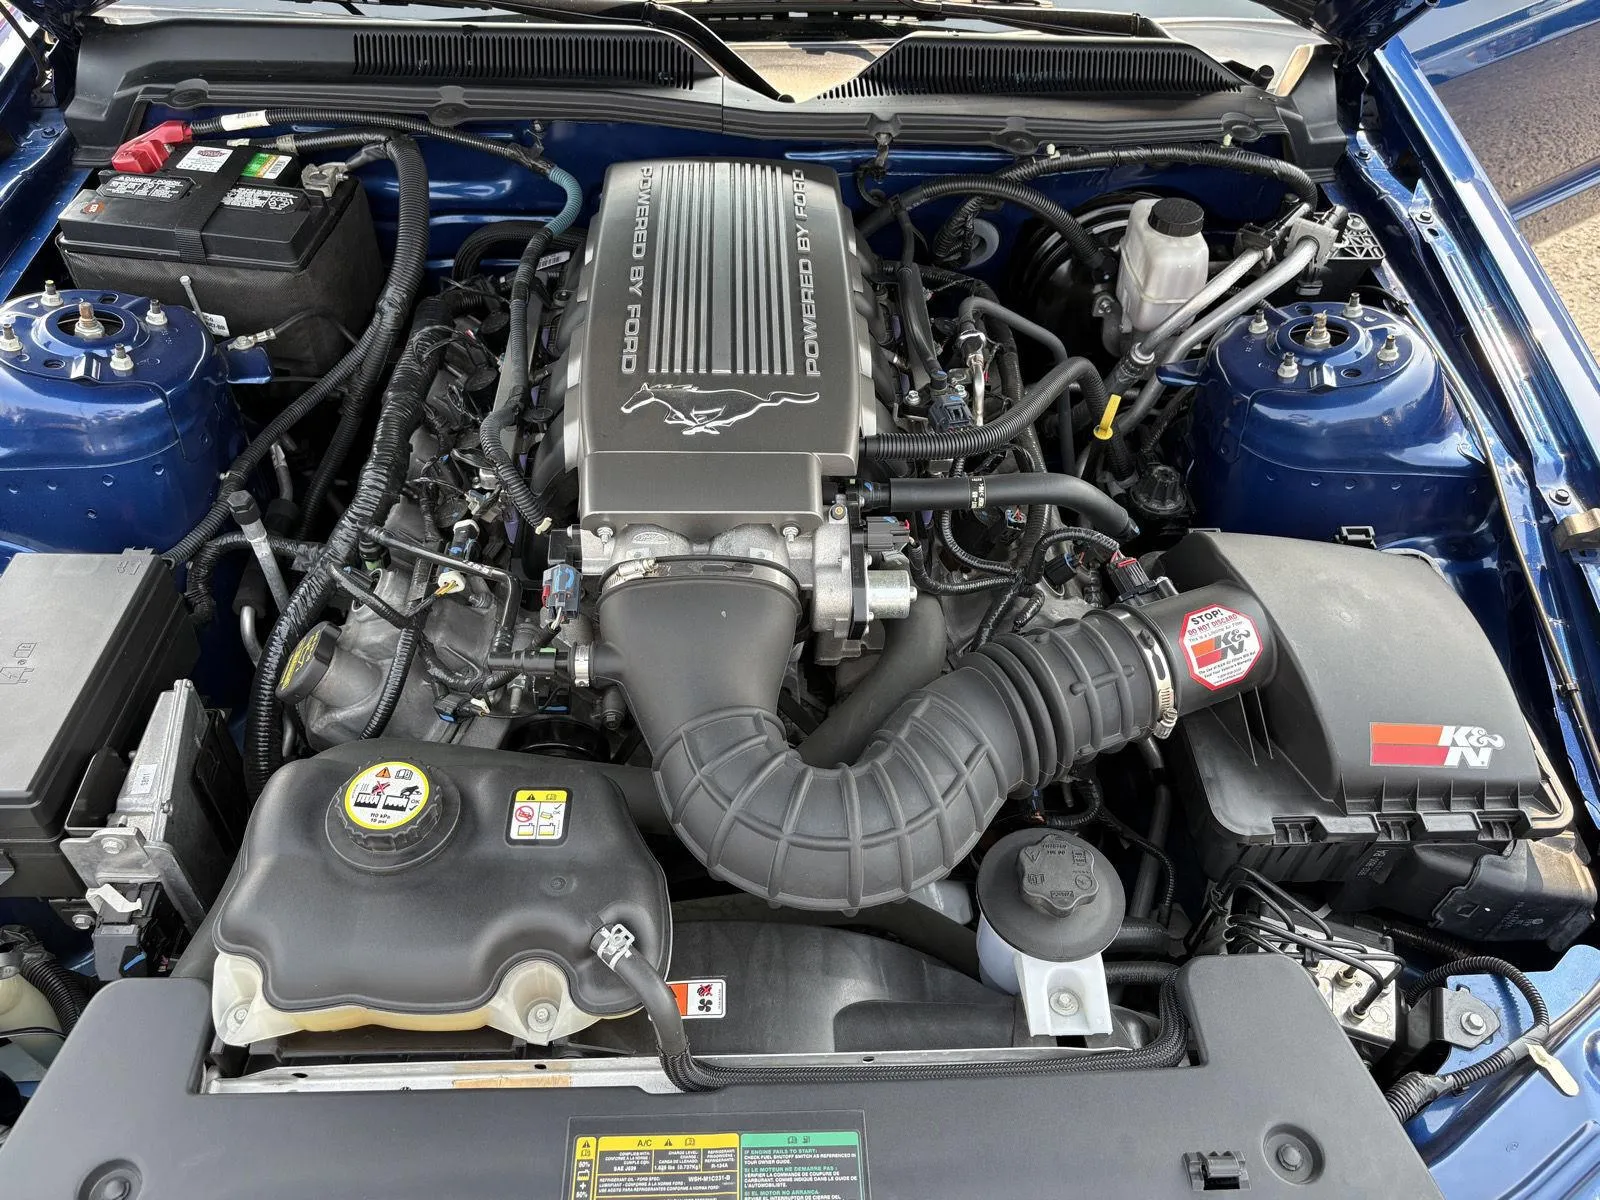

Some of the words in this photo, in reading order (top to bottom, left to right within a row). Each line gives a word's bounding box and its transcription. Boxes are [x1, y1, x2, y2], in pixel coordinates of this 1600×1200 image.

[632, 166, 652, 259] POWERED
[792, 169, 807, 221] FORD
[796, 224, 812, 252] BY
[628, 265, 644, 296] BY
[799, 258, 821, 376] POWERED
[622, 304, 641, 374] FORD
[1191, 609, 1224, 625] STOP!
[1198, 623, 1210, 632] NOT
[1211, 614, 1238, 626] DISCARD
[1214, 629, 1250, 660] K&N
[1438, 726, 1505, 768] K&N
